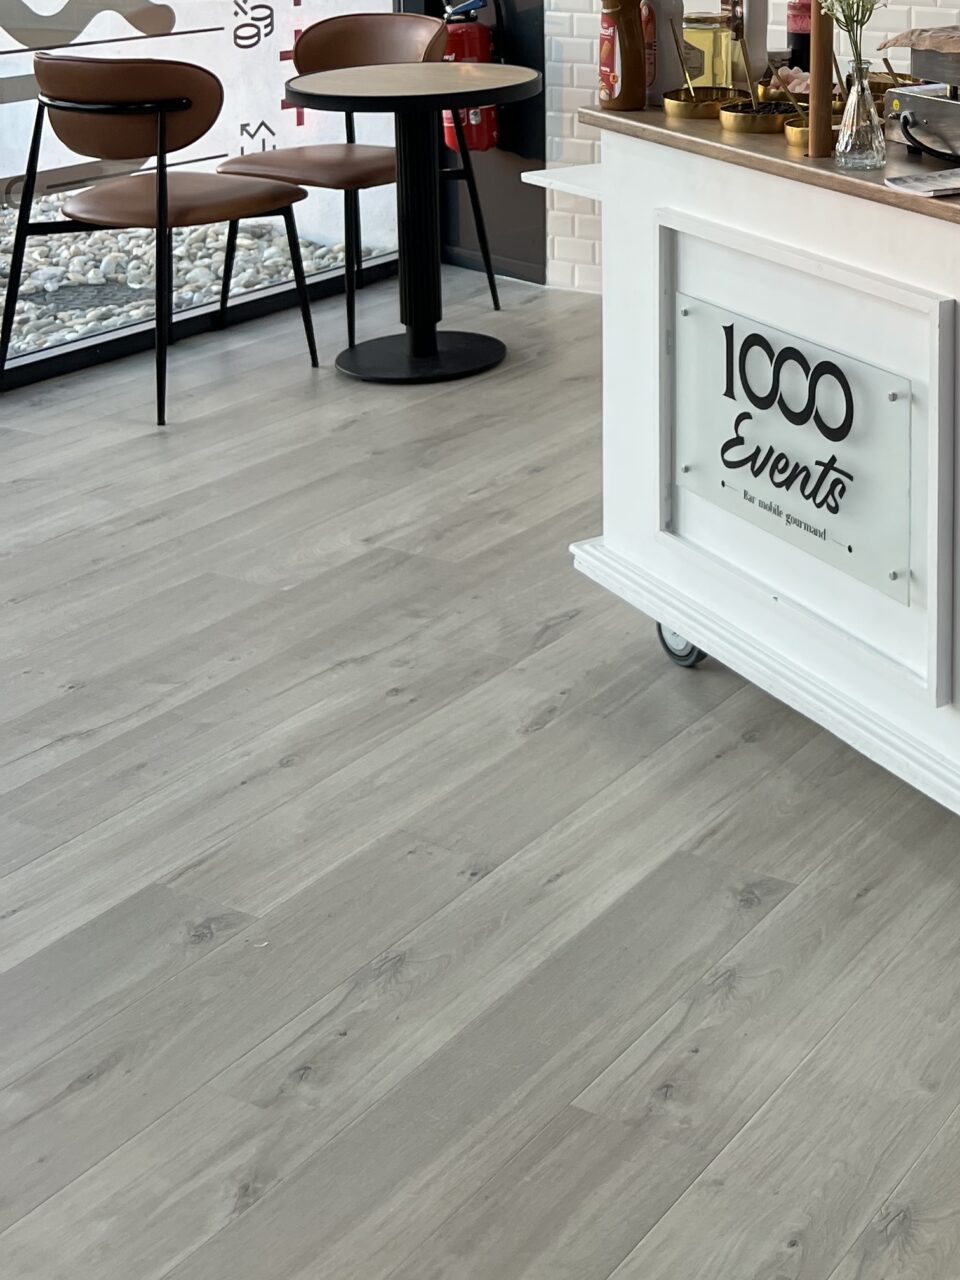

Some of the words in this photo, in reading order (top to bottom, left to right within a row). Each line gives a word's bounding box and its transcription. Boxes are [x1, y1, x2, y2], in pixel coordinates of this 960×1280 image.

[721, 322, 854, 442] 1000
[720, 411, 854, 515] Events
[743, 488, 757, 505] Bar
[758, 499, 784, 519] mobile
[785, 513, 827, 541] gourmand
